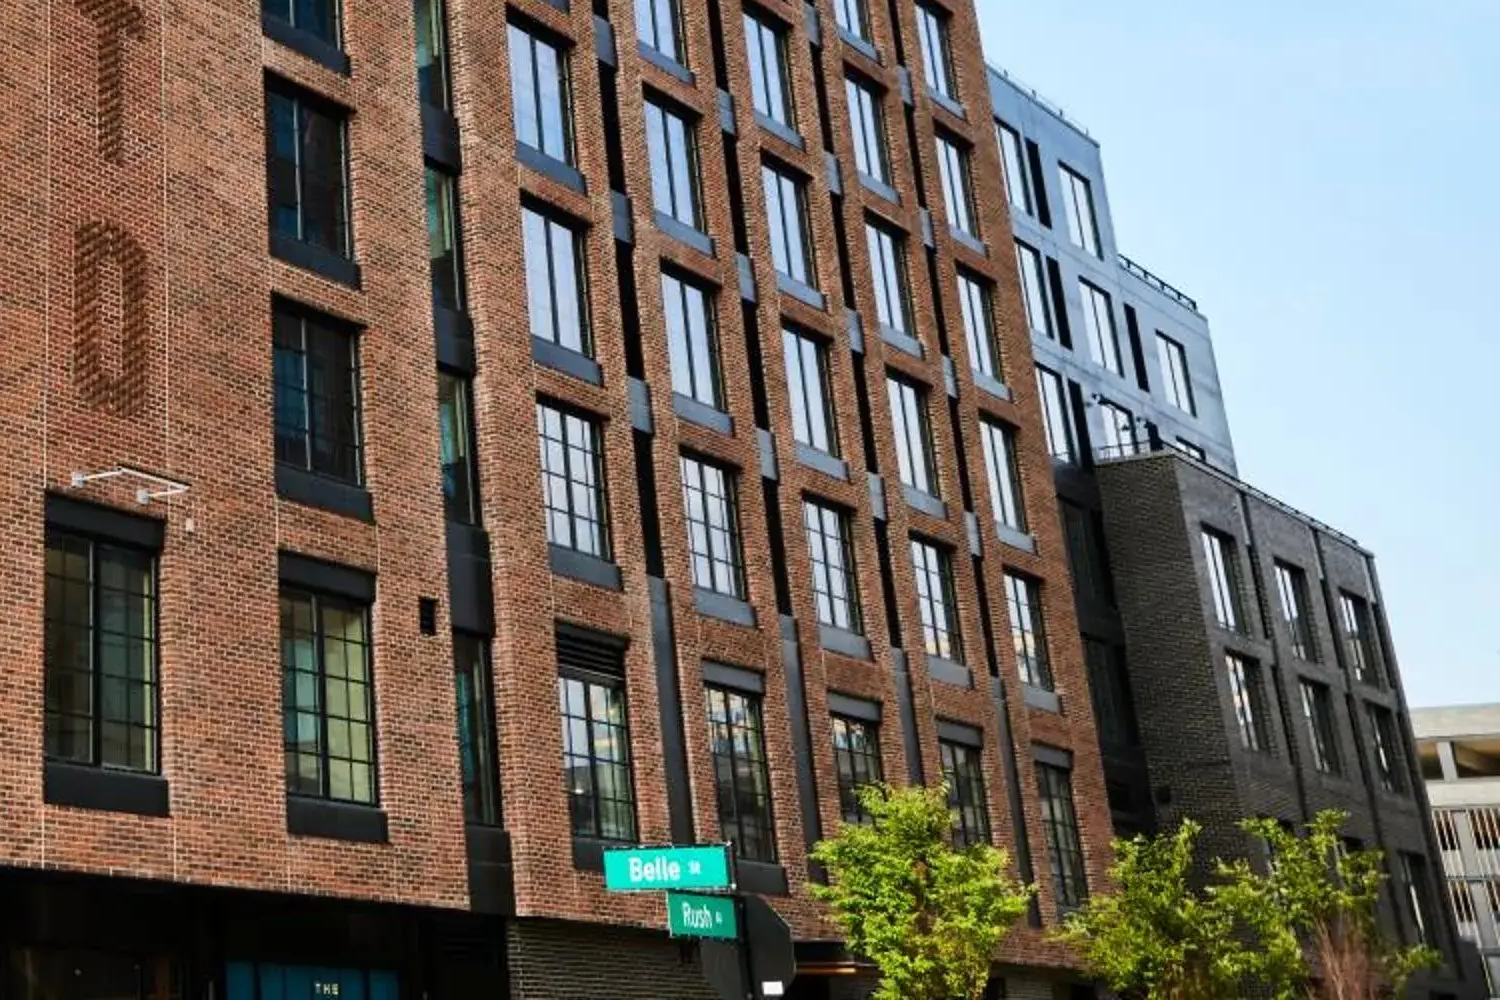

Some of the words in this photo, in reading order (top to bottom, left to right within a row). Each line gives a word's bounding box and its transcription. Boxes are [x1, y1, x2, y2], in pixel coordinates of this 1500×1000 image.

[628, 855, 680, 882] Belle
[682, 901, 713, 928] Rush
[315, 983, 339, 995] THE
